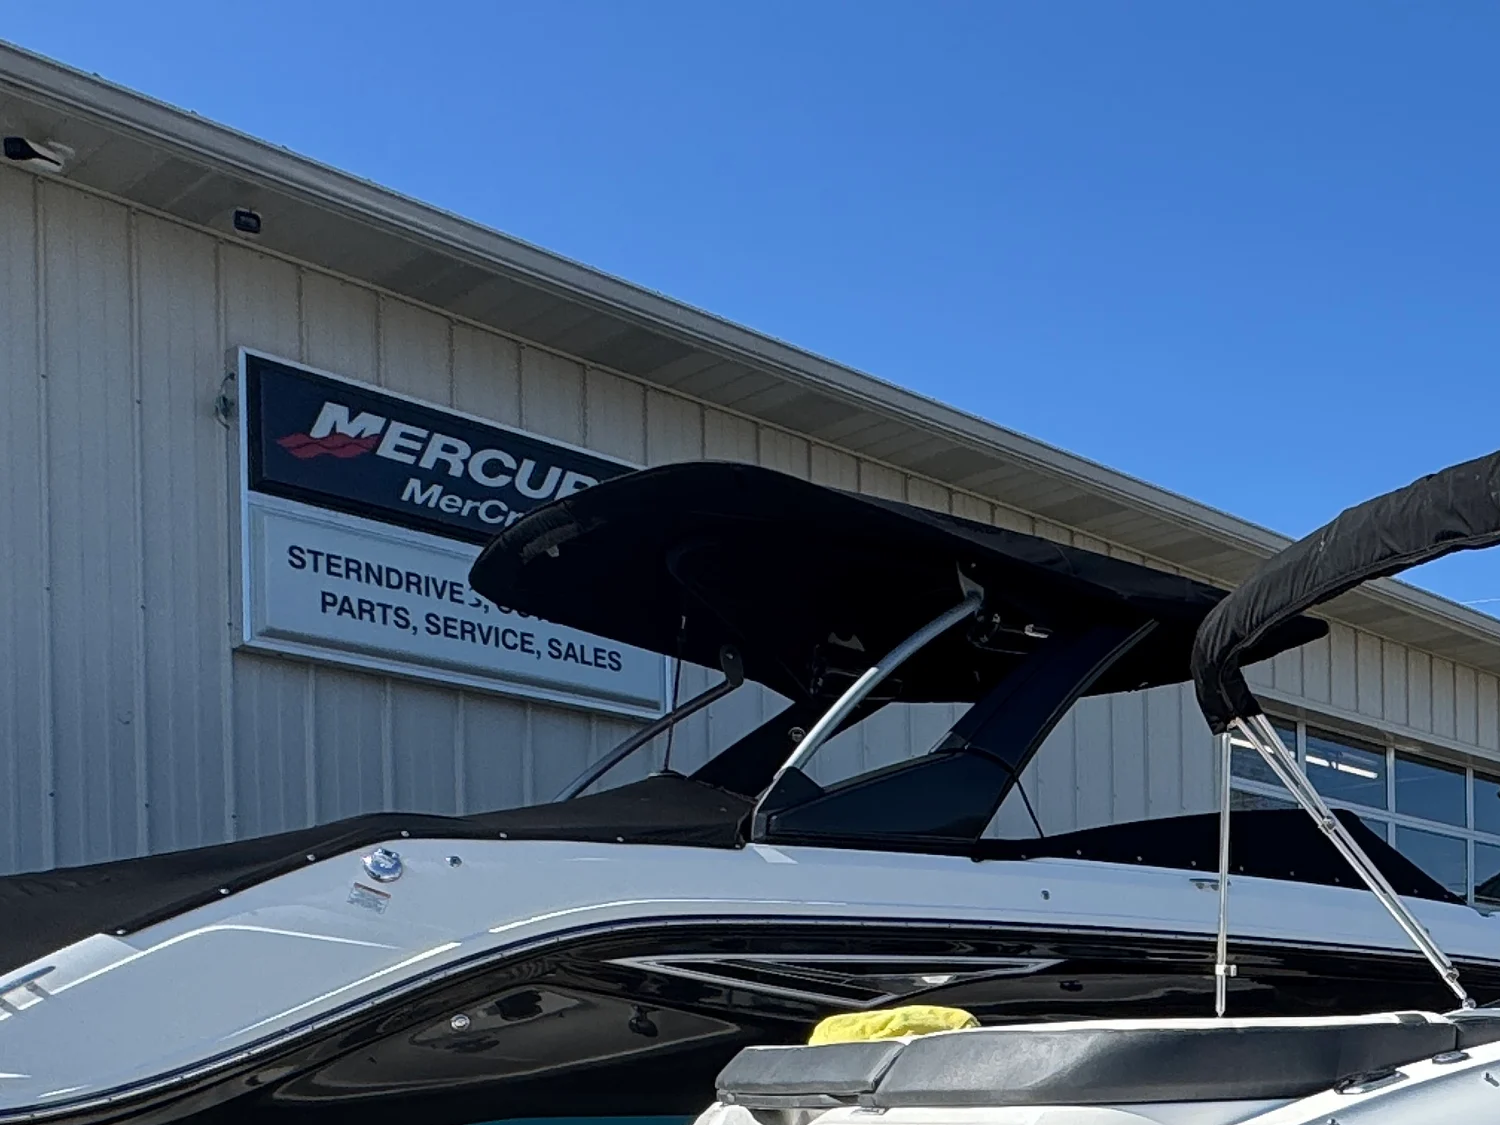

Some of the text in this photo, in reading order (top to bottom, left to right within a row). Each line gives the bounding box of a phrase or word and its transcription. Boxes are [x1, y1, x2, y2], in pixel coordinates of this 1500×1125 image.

[310, 401, 606, 500] MERCUR
[401, 477, 524, 527] MerCr
[320, 590, 622, 672] PARTS, SERVICE, SALES
